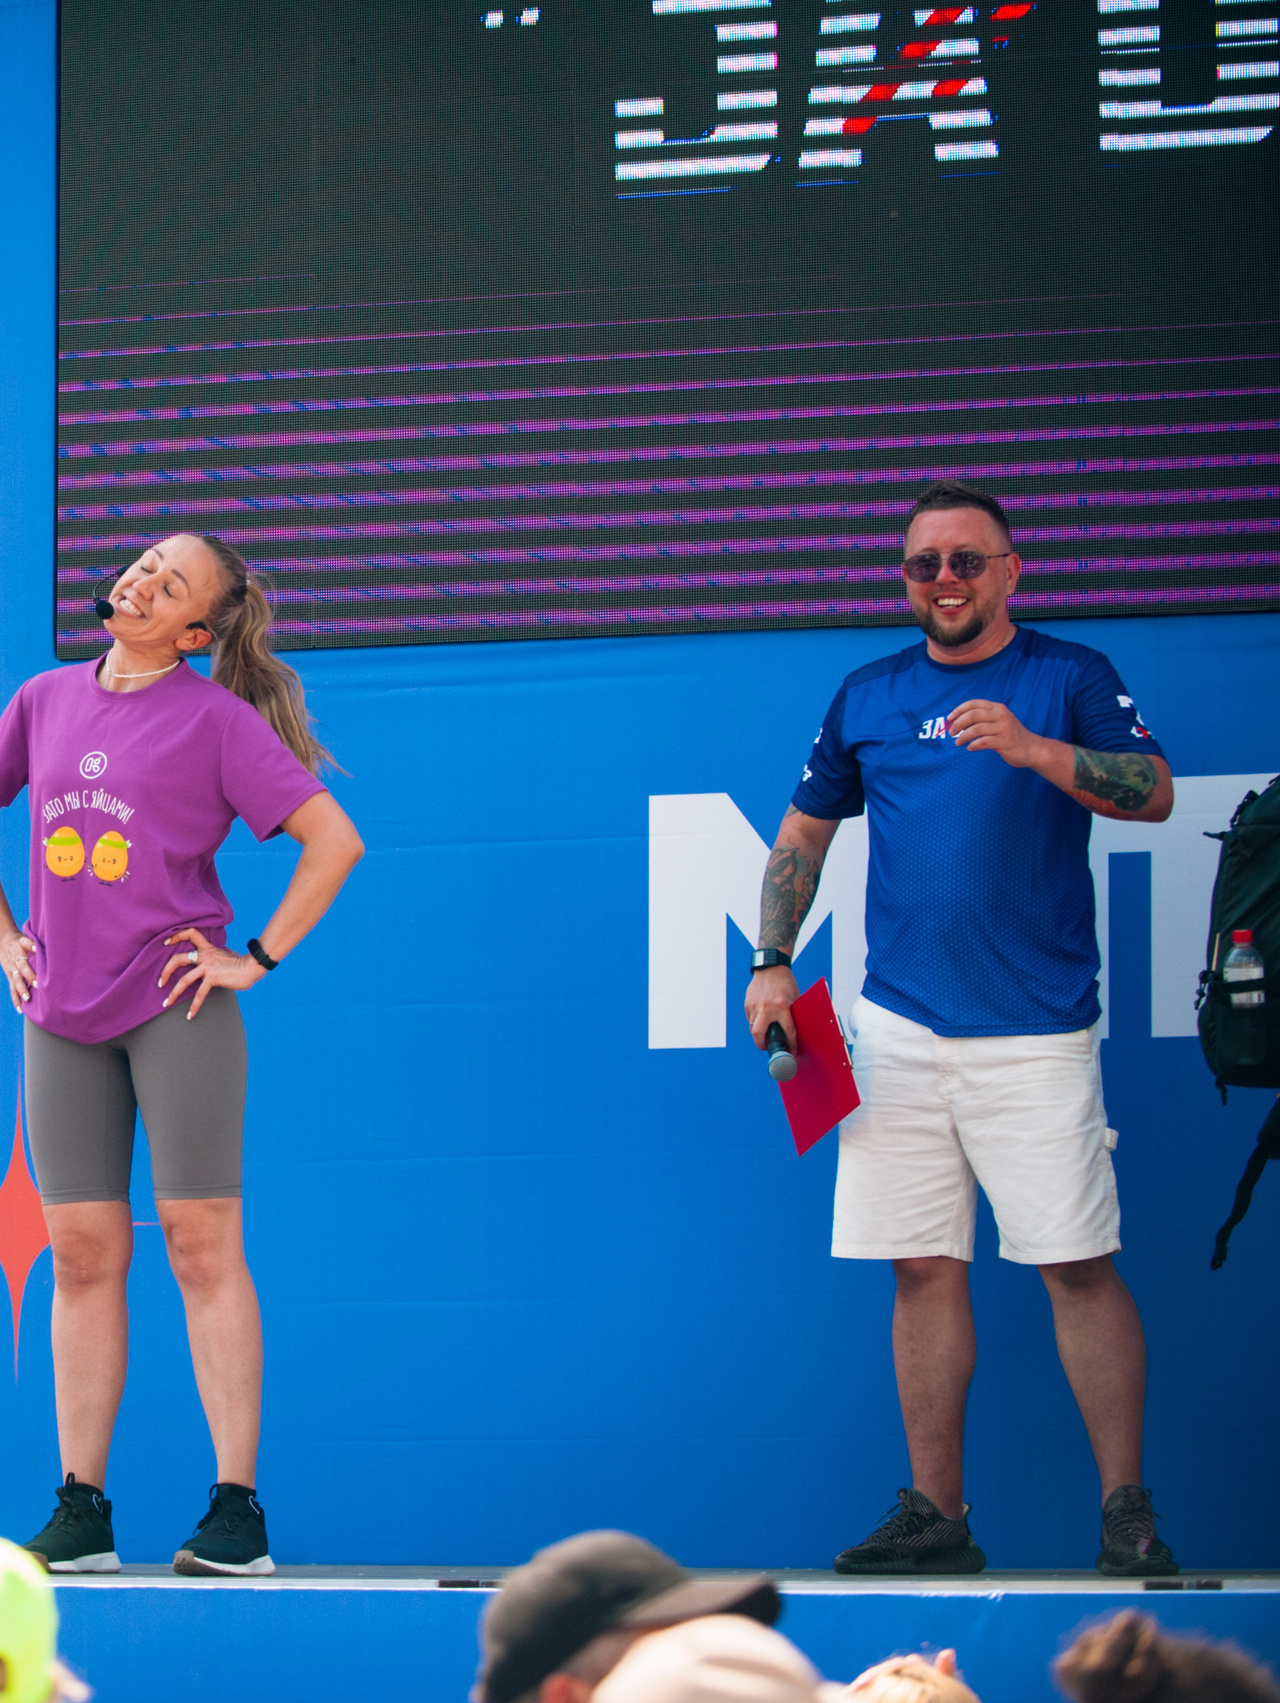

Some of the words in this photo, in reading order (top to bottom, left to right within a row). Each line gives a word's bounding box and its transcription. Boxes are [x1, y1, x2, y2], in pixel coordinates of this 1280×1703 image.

[918, 716, 966, 740] ЗА
[42, 797, 65, 824] ЗАТО
[63, 790, 81, 812] МЫ
[82, 789, 90, 809] С
[90, 787, 135, 825] ЯЙЦАМИ!
